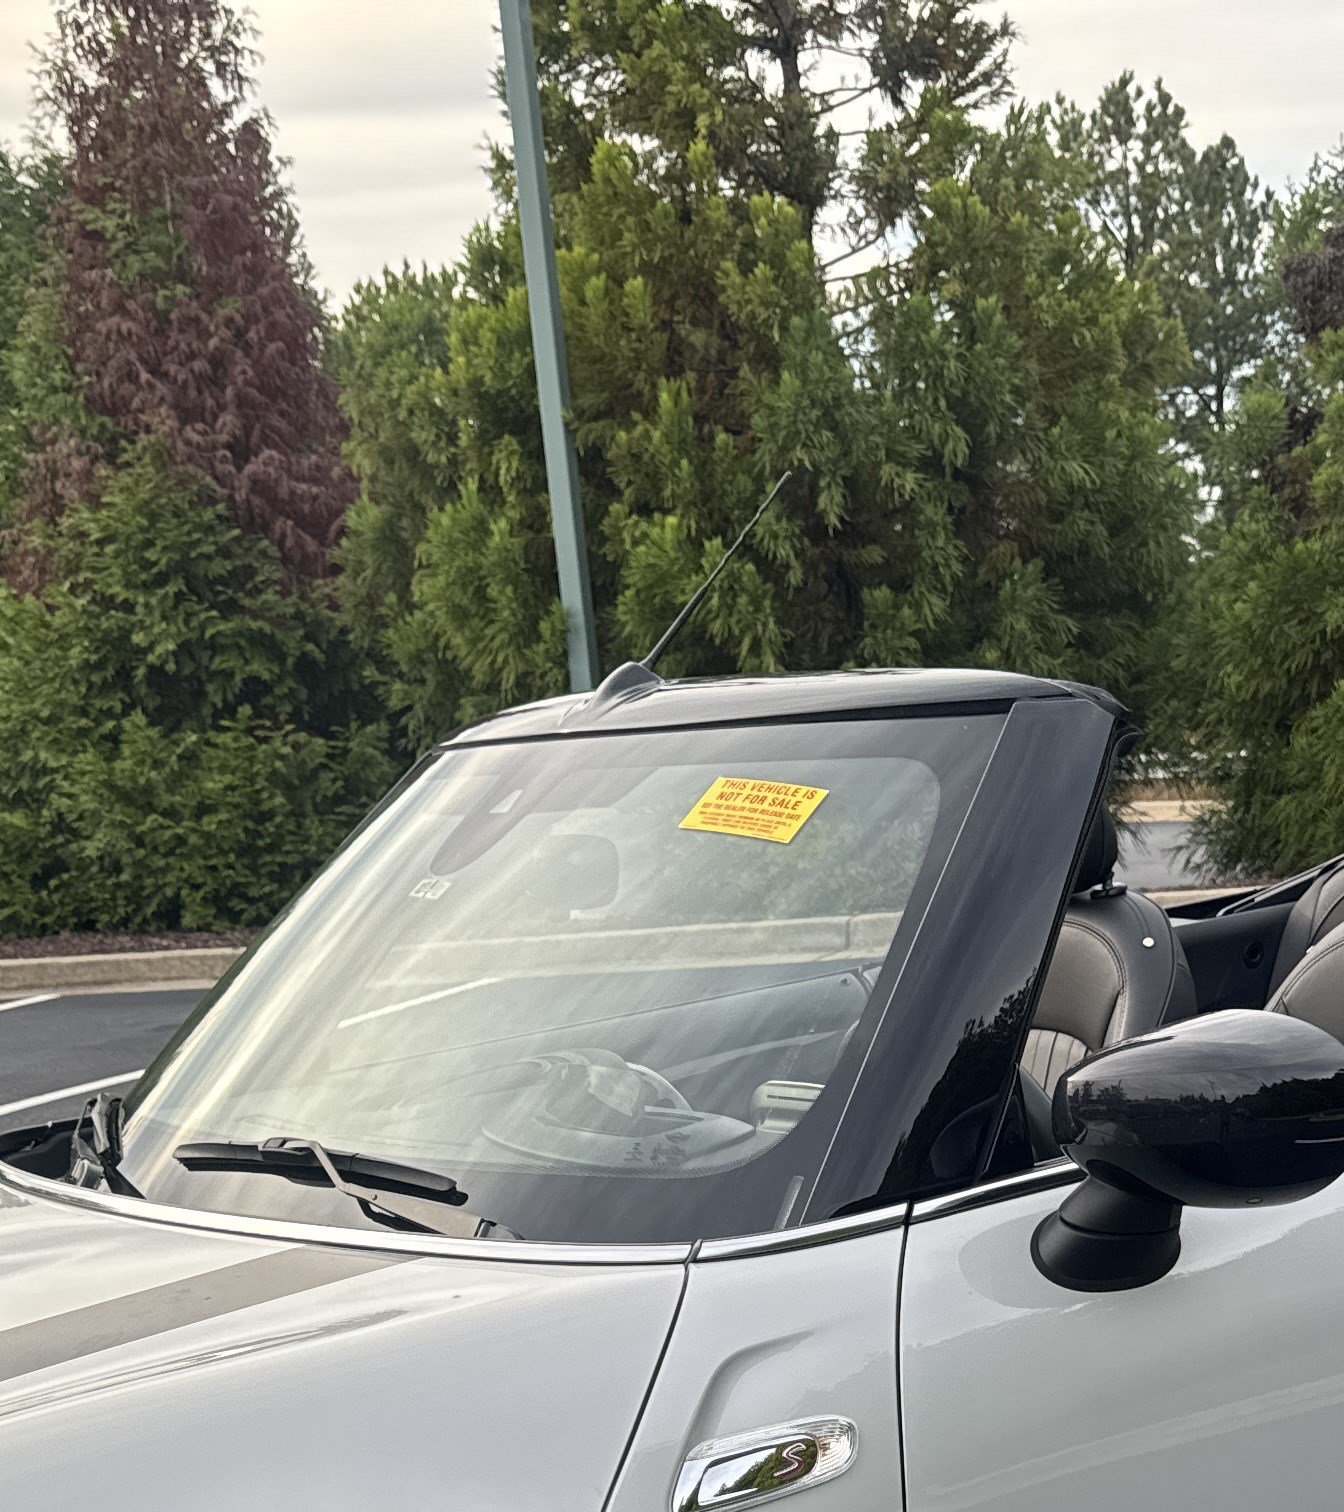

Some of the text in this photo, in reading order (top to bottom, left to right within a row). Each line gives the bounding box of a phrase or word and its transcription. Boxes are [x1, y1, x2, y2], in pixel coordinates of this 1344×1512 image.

[721, 780, 817, 800] THIS VEHICLE IS
[716, 791, 802, 811] NOT FOR SALE
[773, 1442, 806, 1479] S
